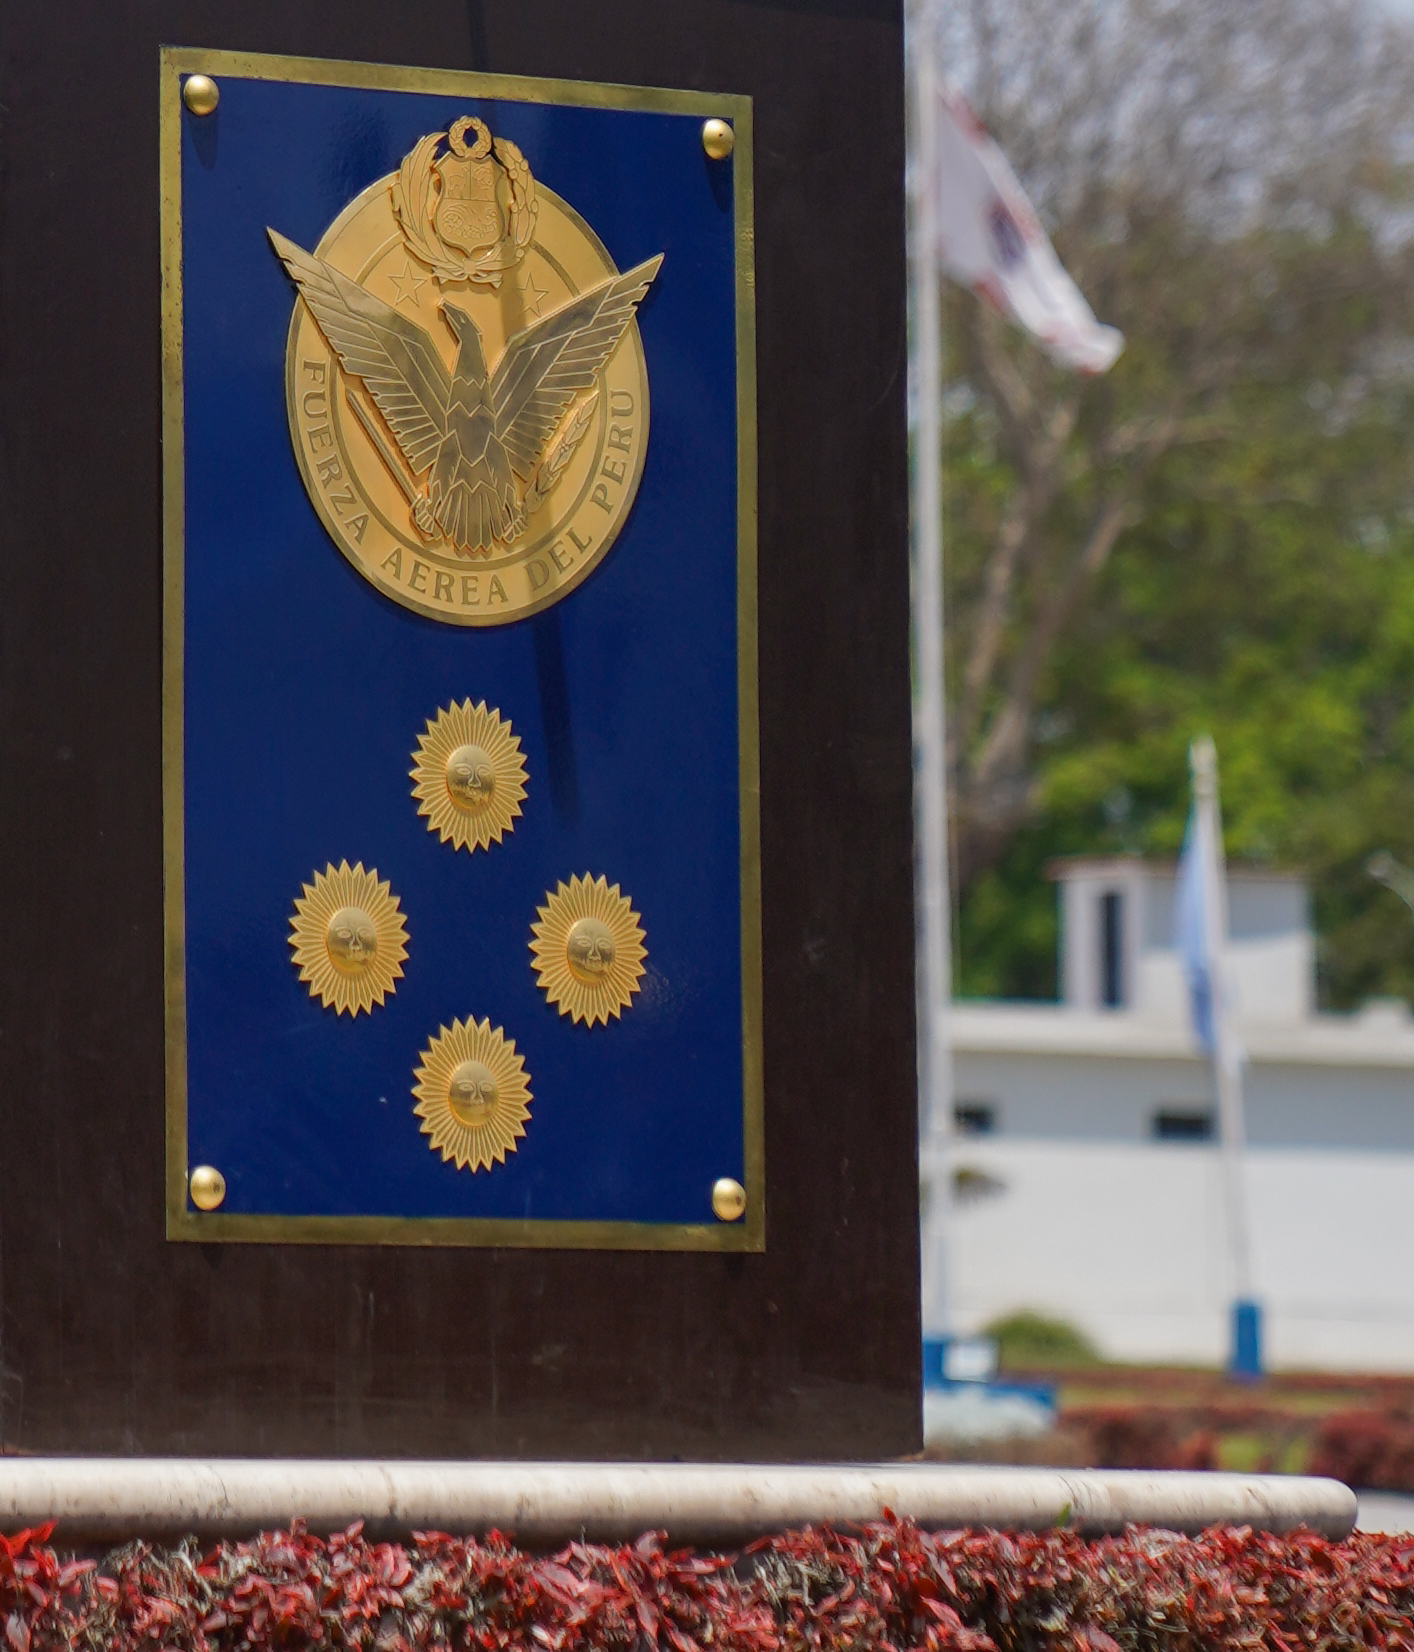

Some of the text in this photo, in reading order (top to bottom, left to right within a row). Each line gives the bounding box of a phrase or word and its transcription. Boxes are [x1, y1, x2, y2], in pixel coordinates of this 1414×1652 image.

[302, 358, 635, 606] FUERZA AEREA DEL PERU
